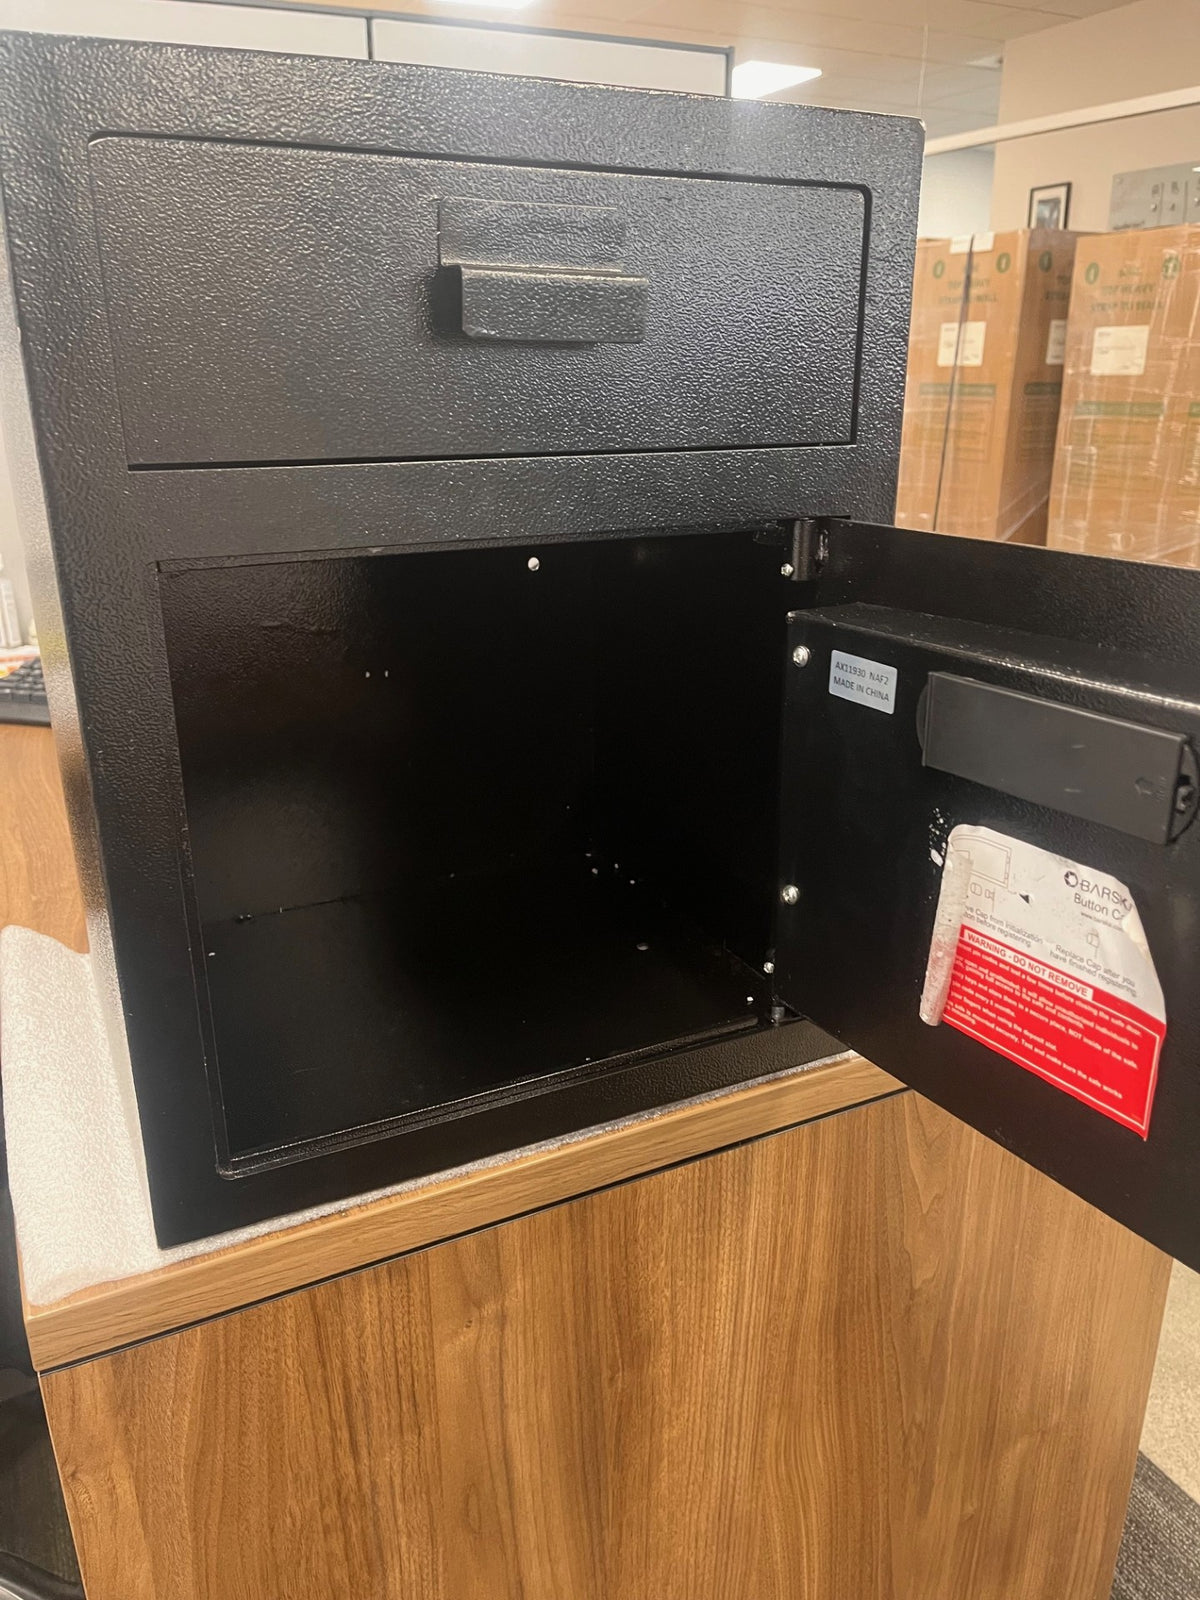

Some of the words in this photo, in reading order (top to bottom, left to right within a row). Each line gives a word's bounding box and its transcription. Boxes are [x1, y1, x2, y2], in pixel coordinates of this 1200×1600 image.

[834, 676, 855, 690] MADE
[856, 684, 864, 693] IN
[866, 687, 890, 702] CHINA
[869, 671, 889, 685] NAF2
[1074, 892, 1108, 916] Button
[967, 932, 1006, 958] WARNING
[1013, 955, 1026, 967] DO
[1028, 962, 1046, 976] NOT
[1048, 971, 1088, 997] REMOVE
[1049, 950, 1067, 963] have
[1056, 944, 1085, 963] Replace
[1086, 958, 1102, 972] Cap
